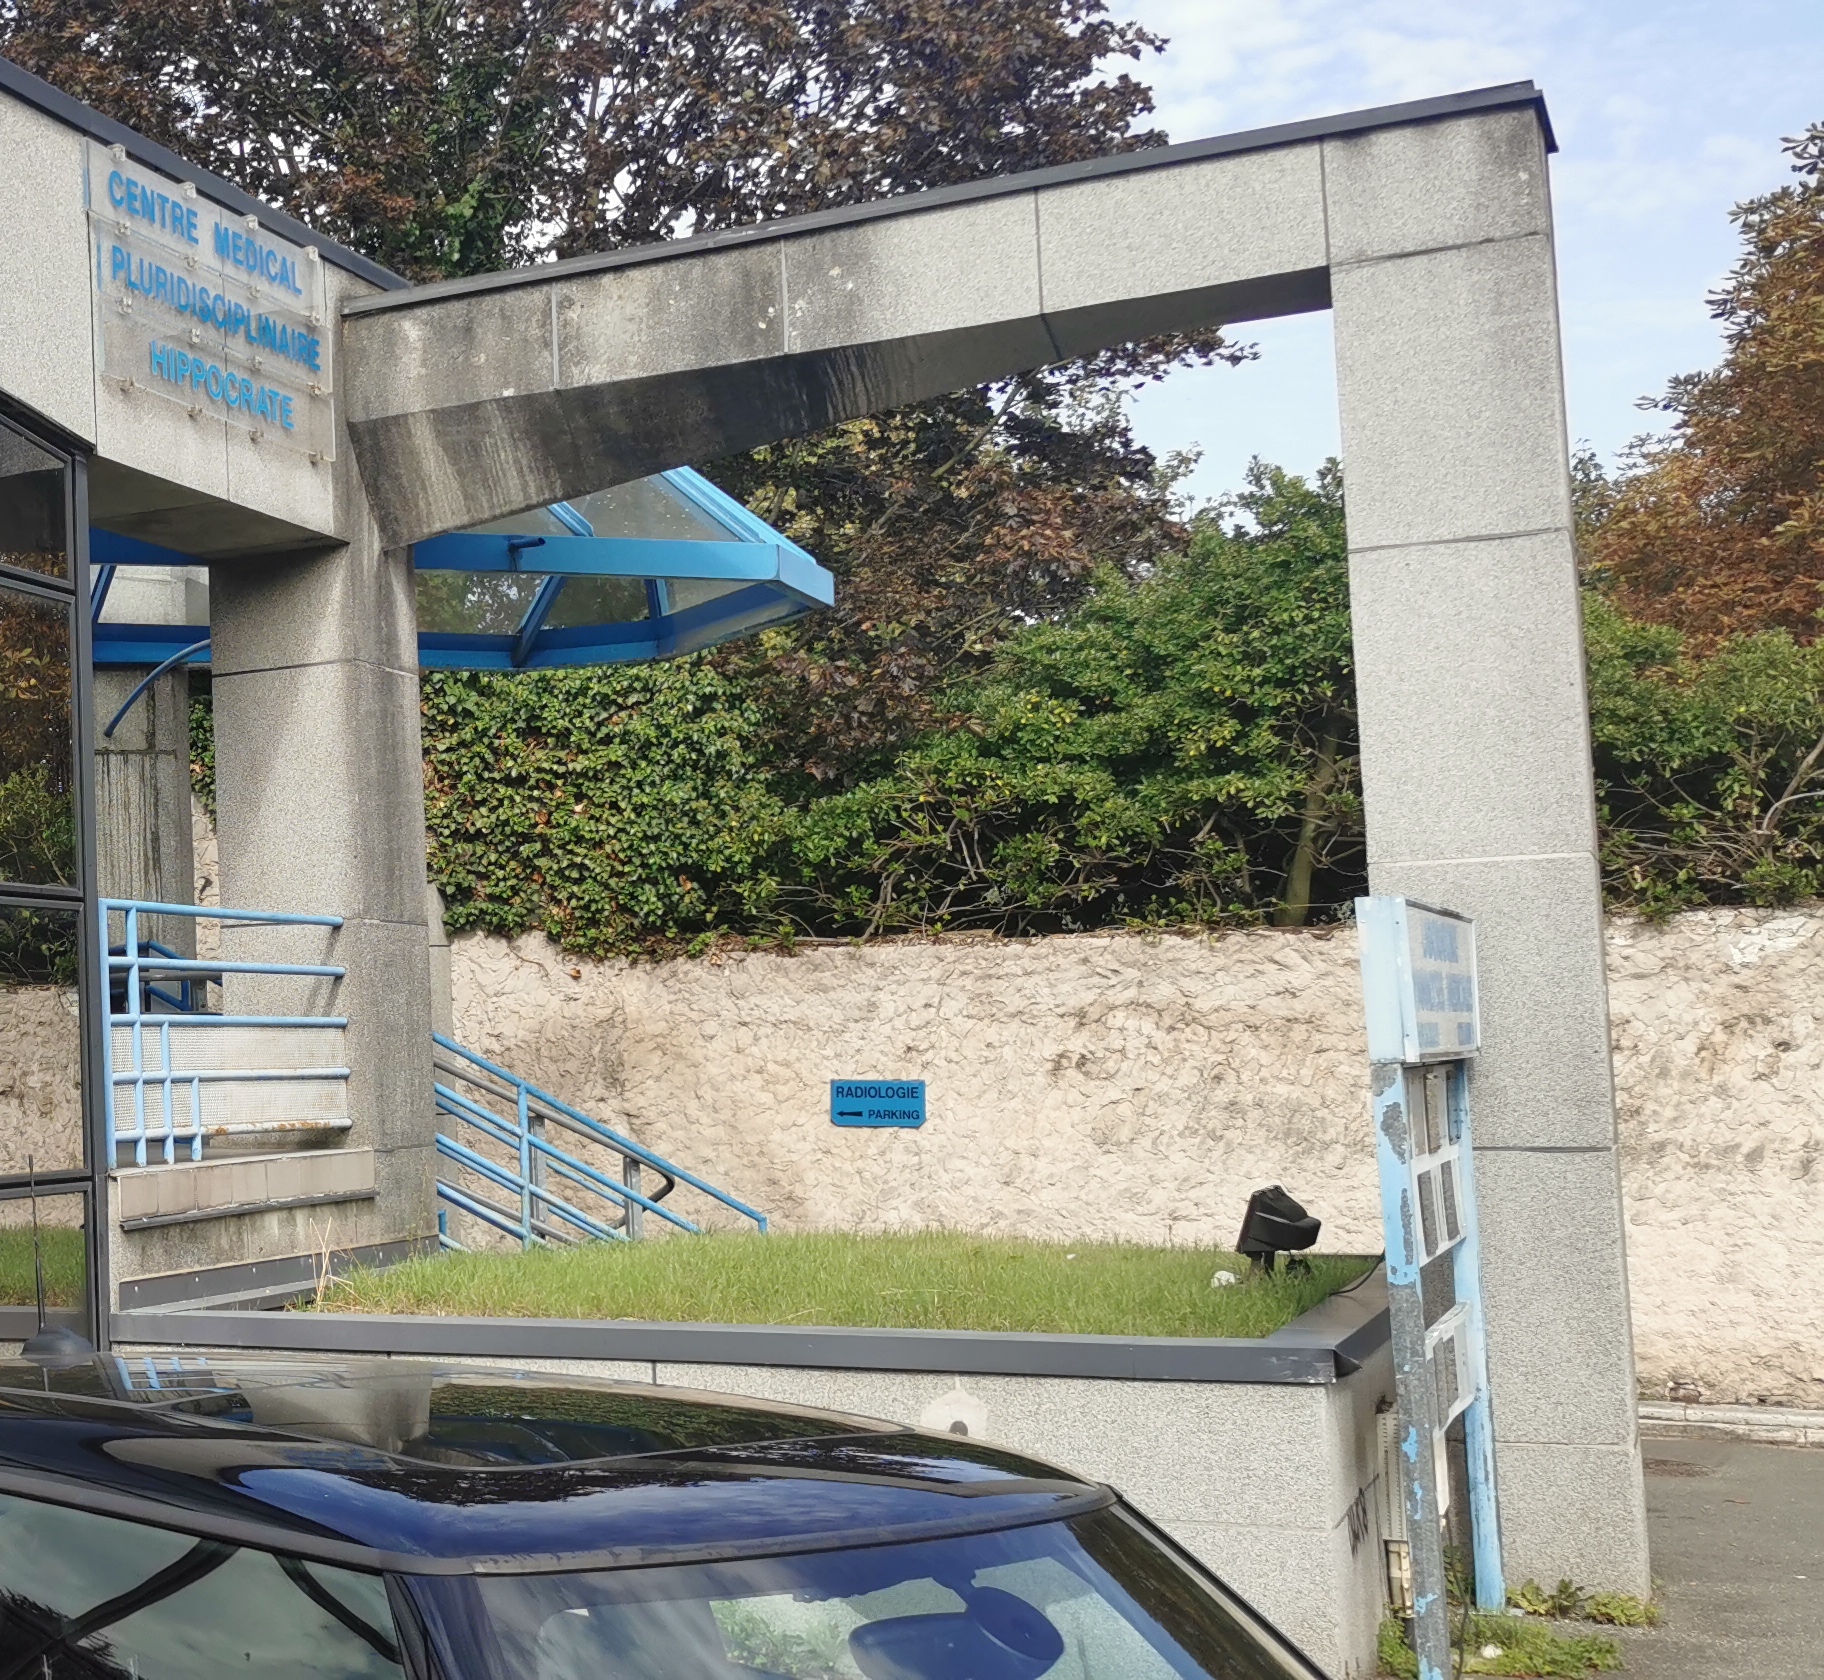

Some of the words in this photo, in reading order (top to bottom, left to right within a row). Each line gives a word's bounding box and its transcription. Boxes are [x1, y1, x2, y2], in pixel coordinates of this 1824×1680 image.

[108, 169, 199, 245] CENTRE
[213, 221, 303, 295] MEDICAL
[111, 245, 321, 372] PLURIDISCIPLINAIRE
[149, 340, 295, 429] HIPPOCRATE
[836, 1086, 919, 1099] RADIOLOGIE
[868, 1109, 920, 1120] PARKING
